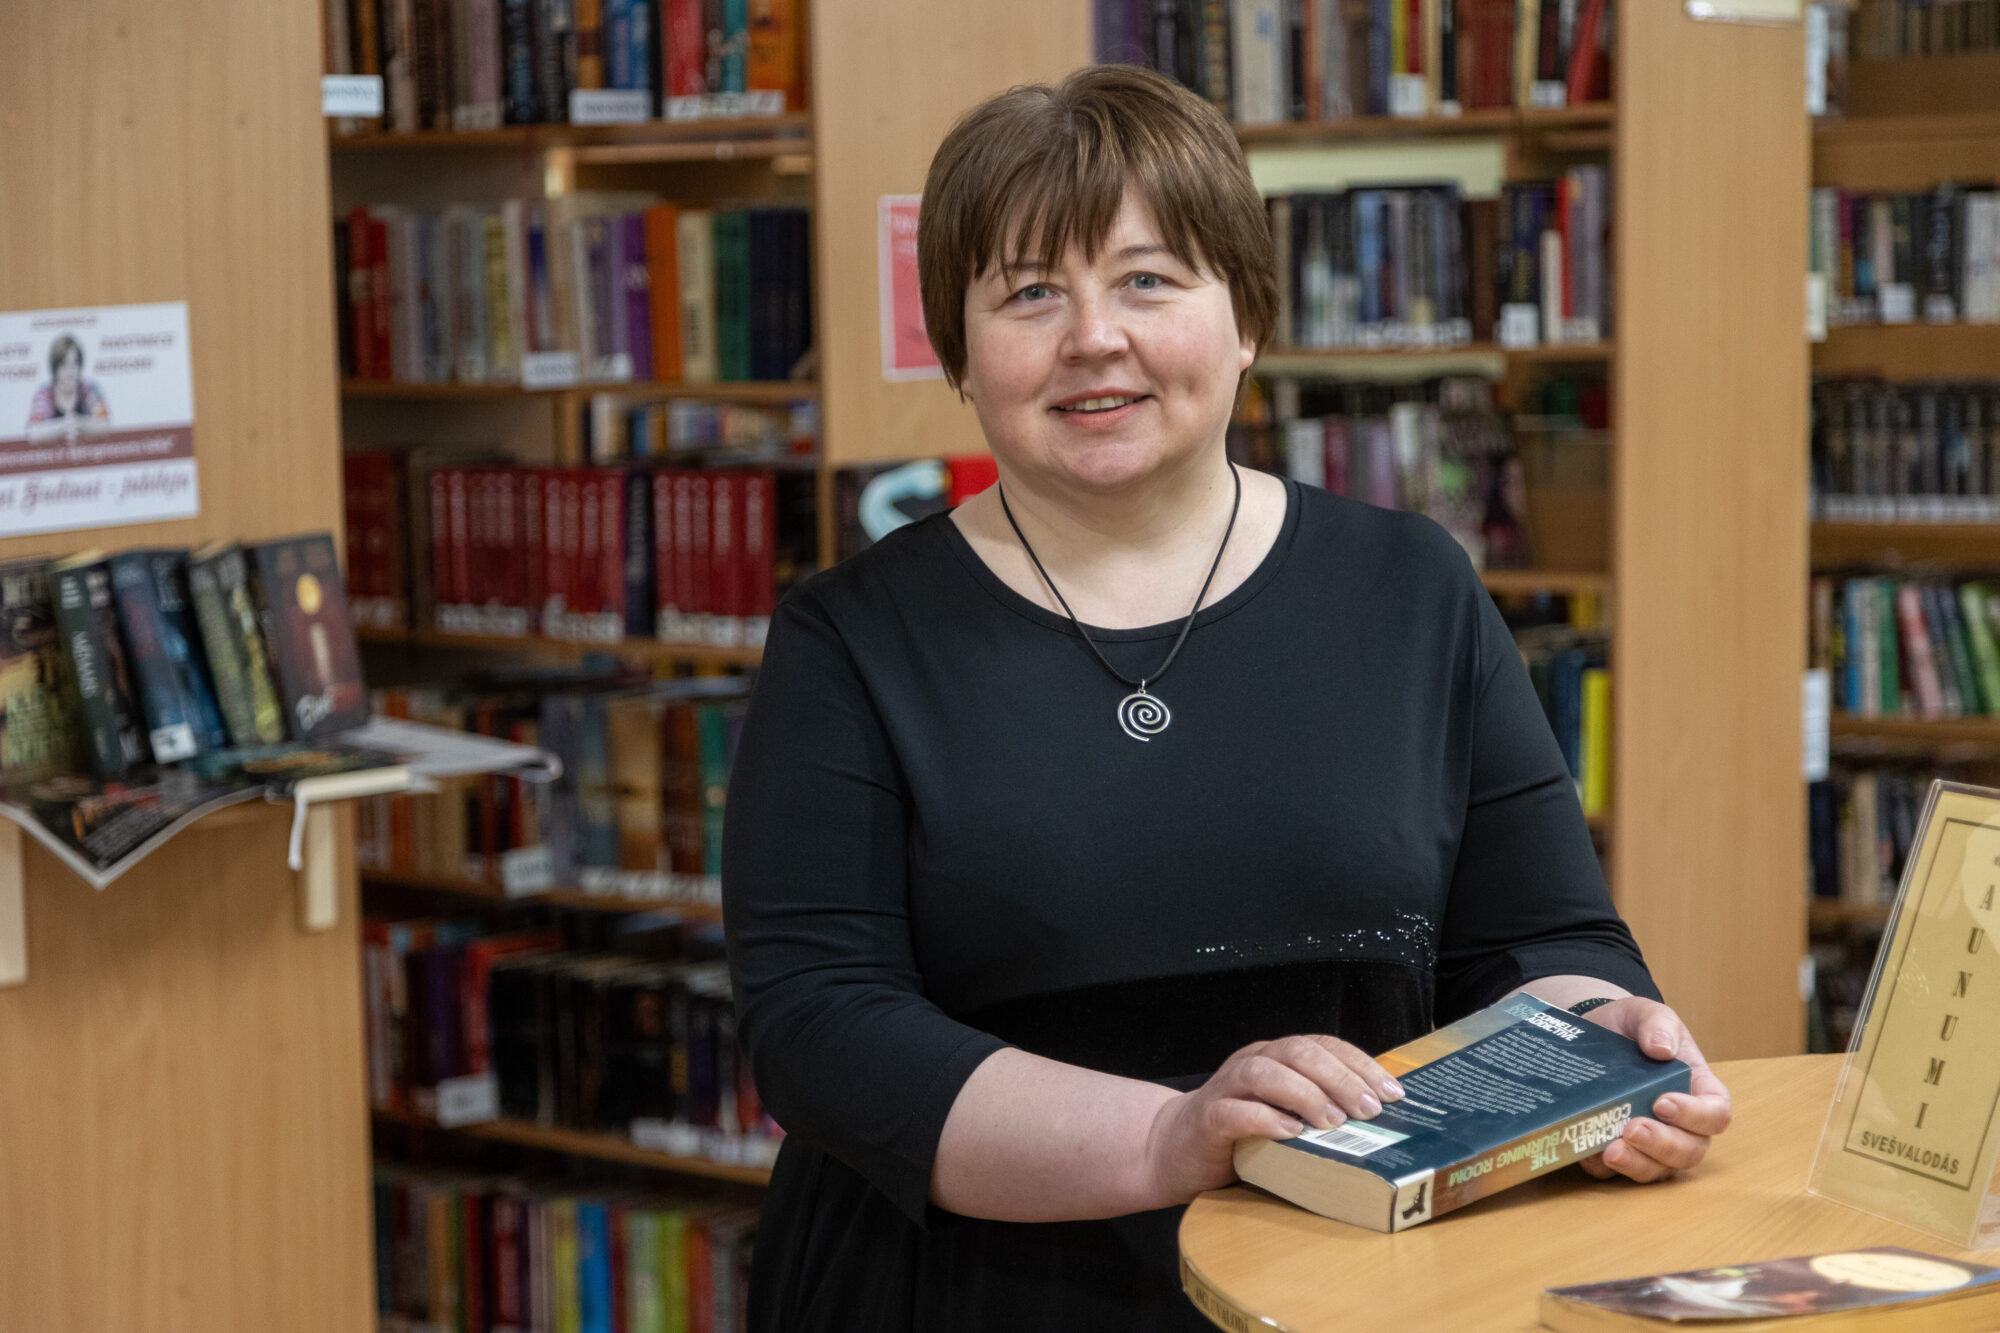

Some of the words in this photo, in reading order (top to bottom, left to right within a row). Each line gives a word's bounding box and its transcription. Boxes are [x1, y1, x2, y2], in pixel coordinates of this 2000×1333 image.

[1525, 1016, 1578, 1042] ADDICTIVE
[1533, 1012, 1585, 1034] CONNELLY
[1560, 1102, 1632, 1144] CONNELLY
[1496, 1130, 1561, 1168] BURNING
[1529, 1146, 1560, 1172] THE
[1449, 1157, 1494, 1187] ROOM
